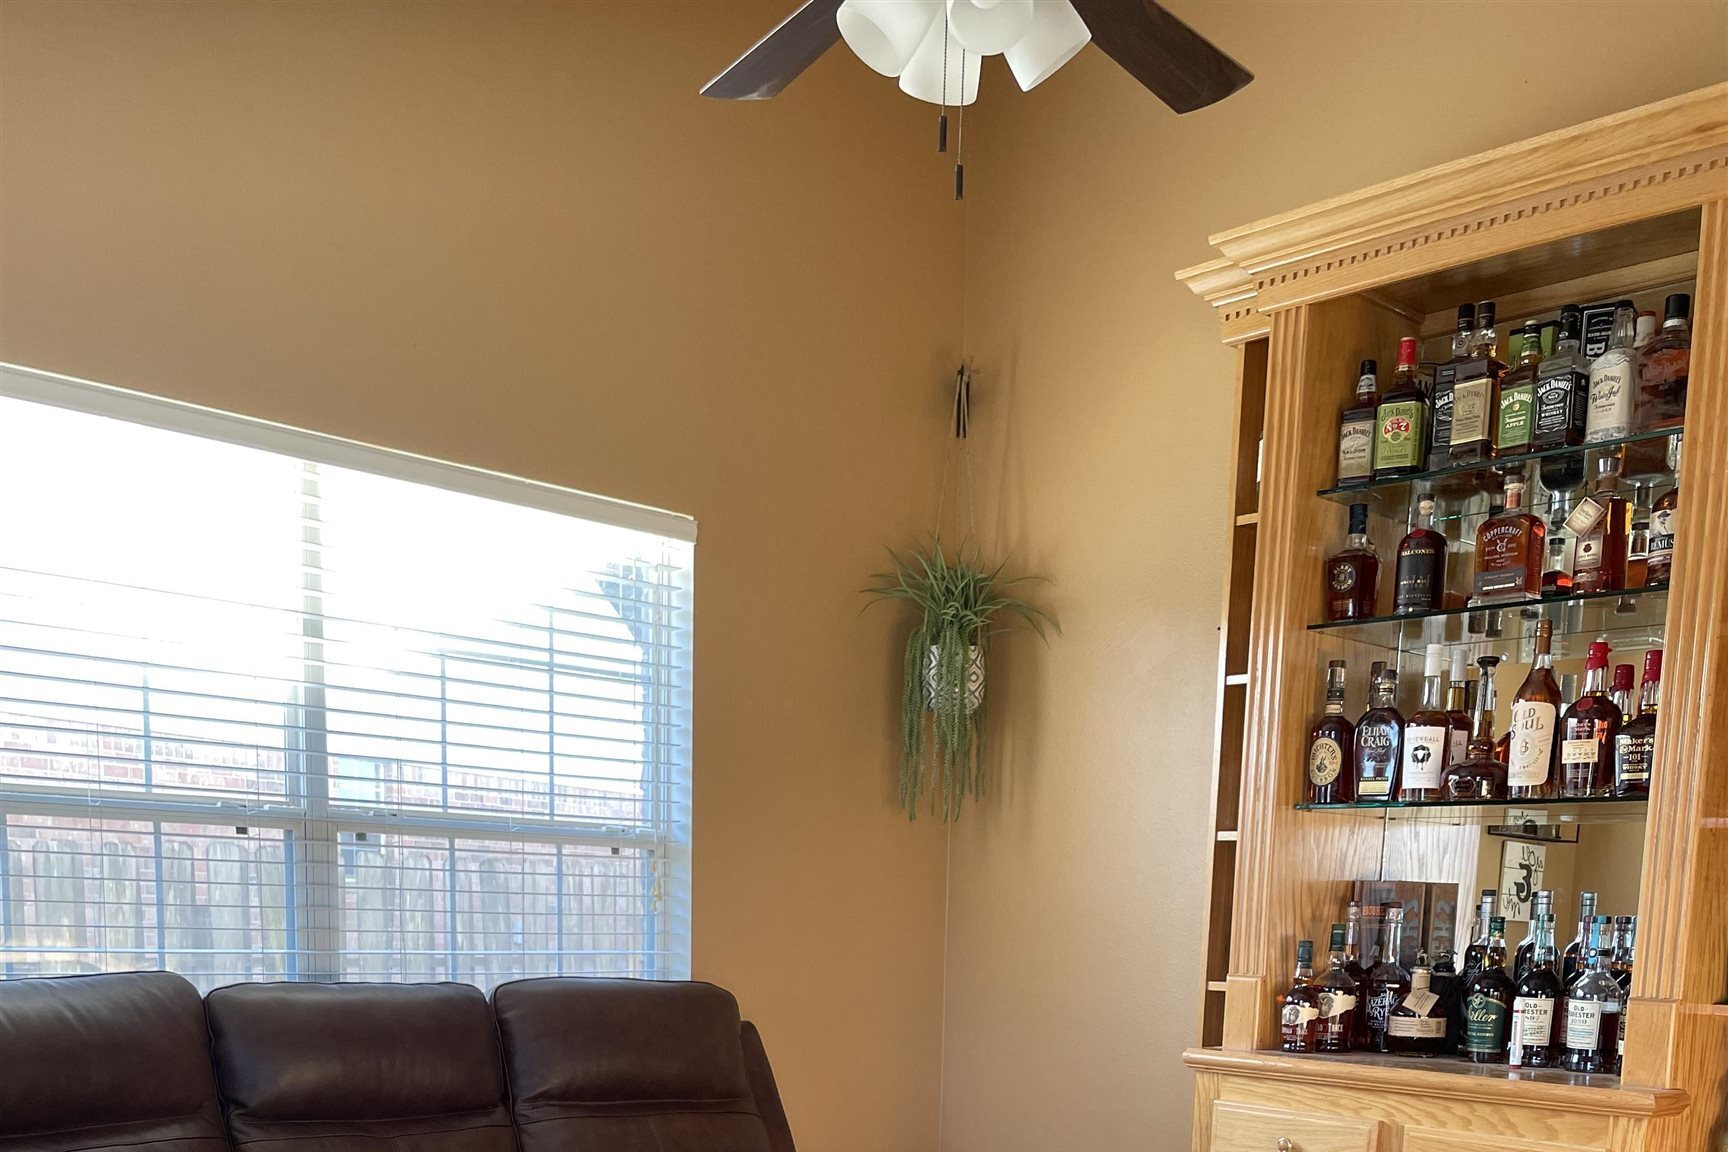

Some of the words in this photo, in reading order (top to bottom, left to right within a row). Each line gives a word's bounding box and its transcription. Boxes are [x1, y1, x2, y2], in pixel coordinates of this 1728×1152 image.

[1537, 383, 1551, 397] JACK
[1550, 379, 1572, 391] DANIEL'S
[1500, 396, 1513, 409] JACK
[1513, 391, 1533, 403] DANIEL'S
[1505, 420, 1525, 428] APPLE
[1482, 526, 1523, 542] COPPERCRAFT
[1361, 736, 1390, 747] CRAIG
[1620, 737, 1654, 745] Maker's
[1573, 1004, 1585, 1012] OLD
